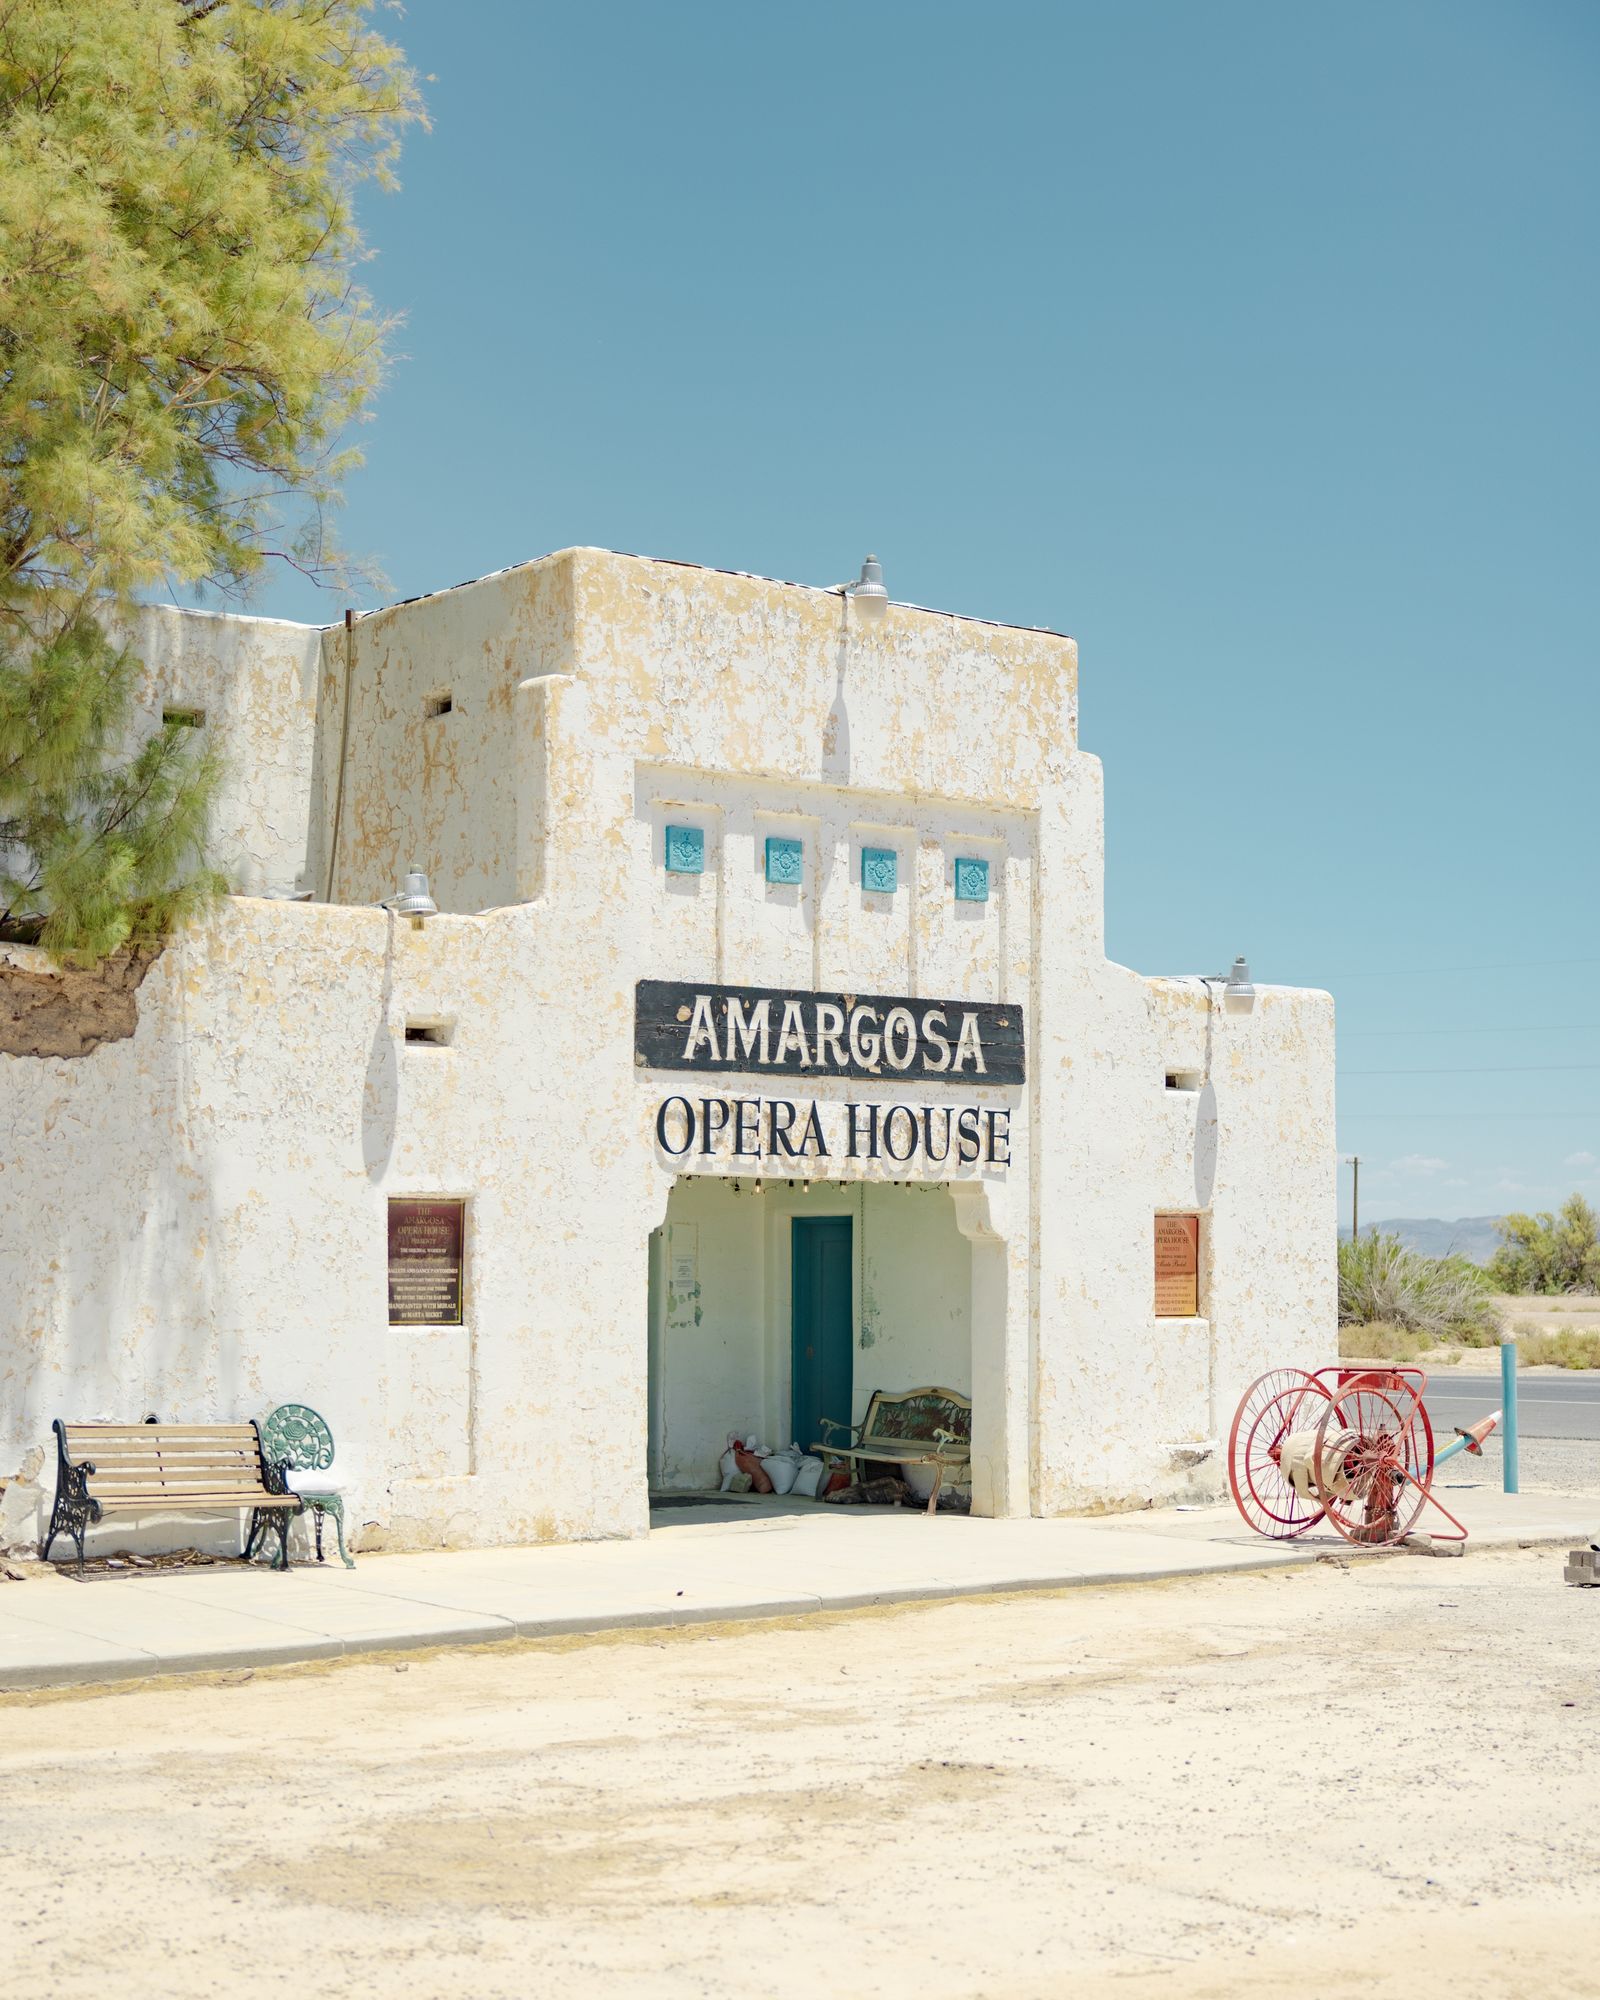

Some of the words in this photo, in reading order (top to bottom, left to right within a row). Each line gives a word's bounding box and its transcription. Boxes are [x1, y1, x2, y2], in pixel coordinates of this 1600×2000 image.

[681, 995, 988, 1075] AMARGOSA
[656, 1096, 832, 1160] OPERA
[844, 1103, 1012, 1167] HOUSE
[416, 1207, 433, 1216] THE
[404, 1216, 445, 1225] AMARGOSA
[397, 1226, 423, 1234] OPERA
[424, 1226, 450, 1235] HOUSE
[1171, 1236, 1190, 1244] HOUSE
